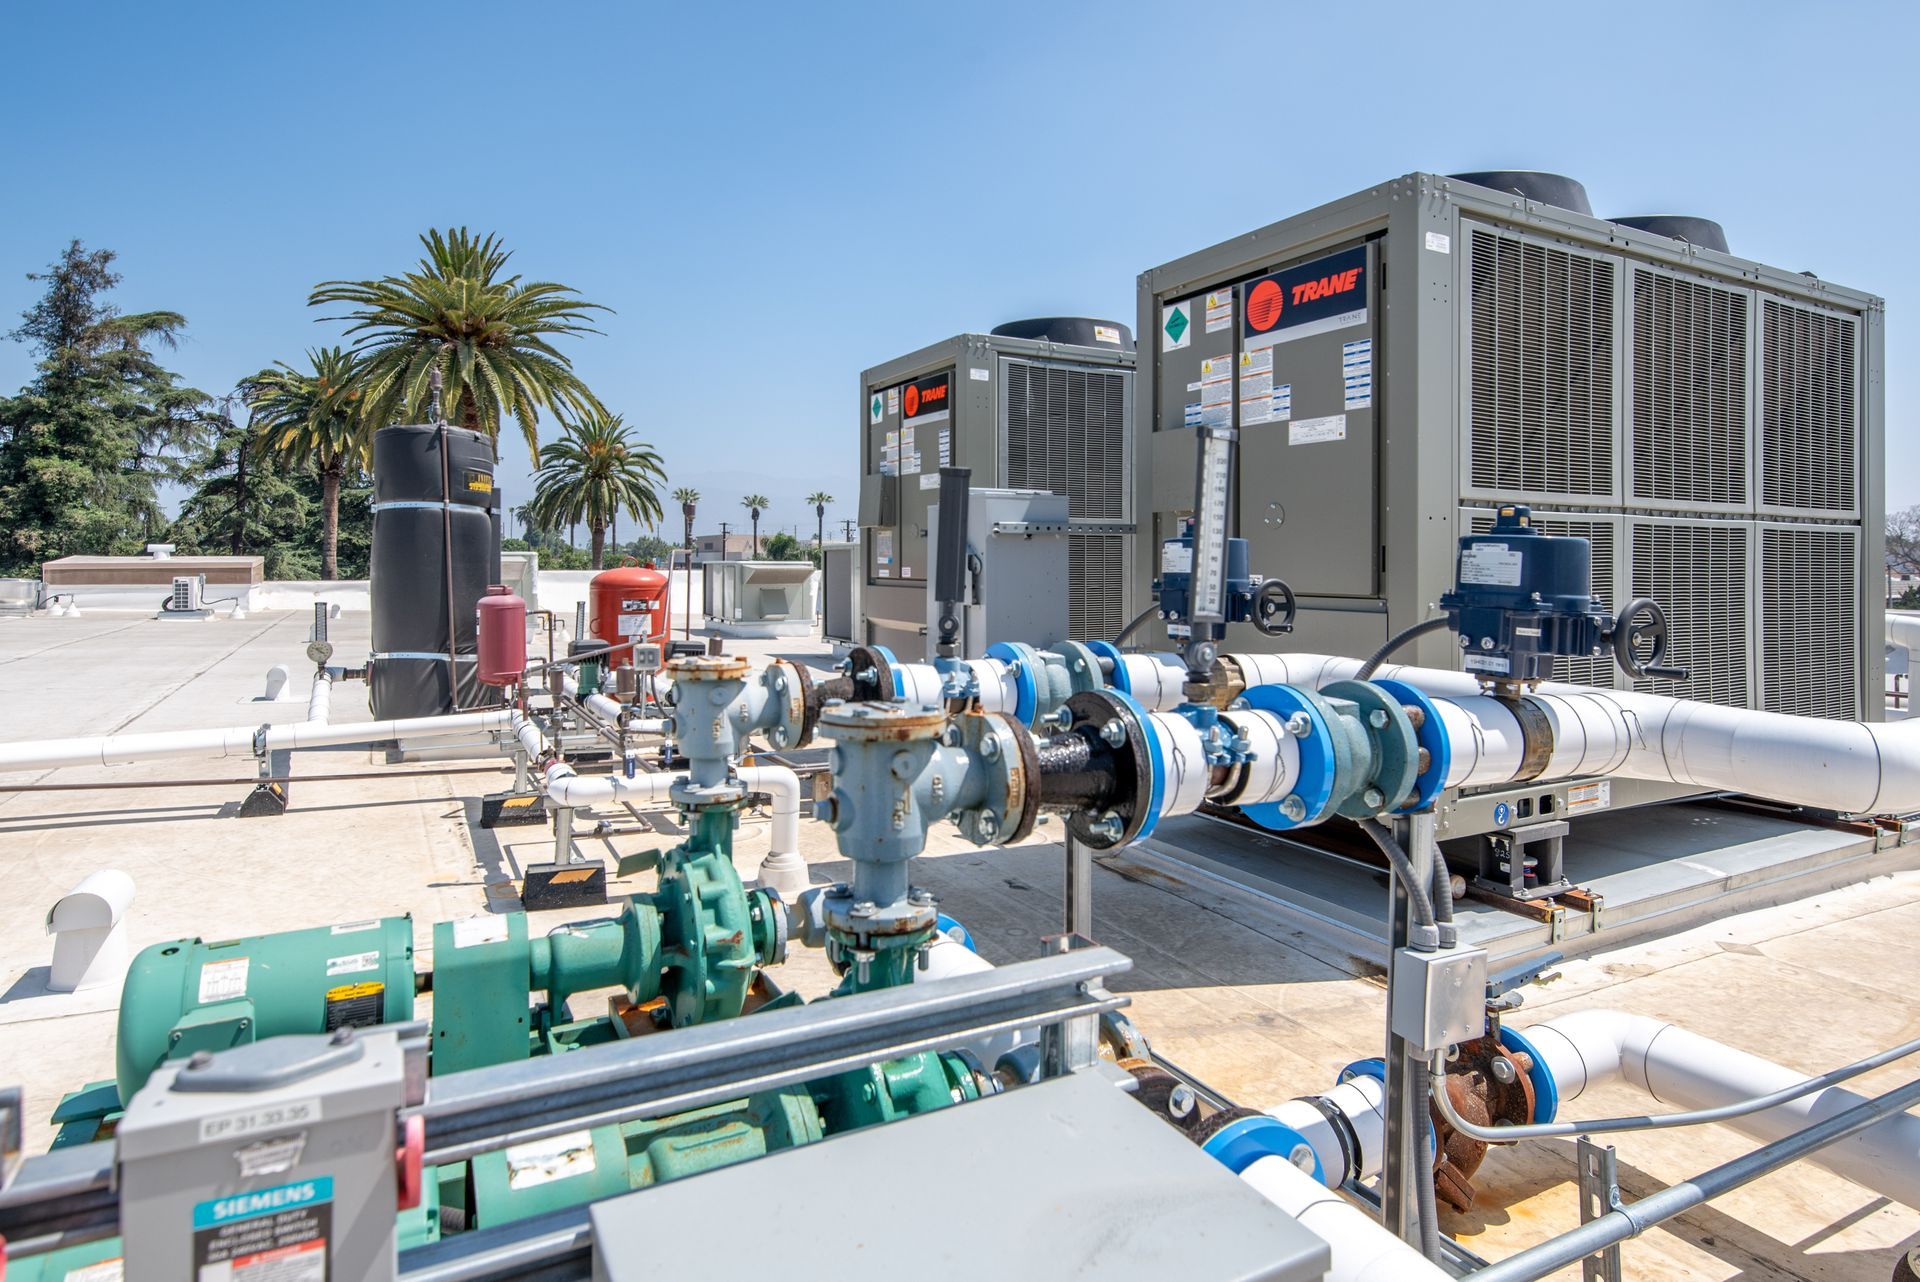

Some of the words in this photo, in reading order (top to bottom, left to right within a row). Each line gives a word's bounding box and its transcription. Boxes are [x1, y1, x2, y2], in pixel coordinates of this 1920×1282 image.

[1292, 268, 1358, 306] TRANE
[921, 384, 947, 403] TRANE
[205, 1119, 232, 1138] EP
[213, 1182, 316, 1220] SIEMENS
